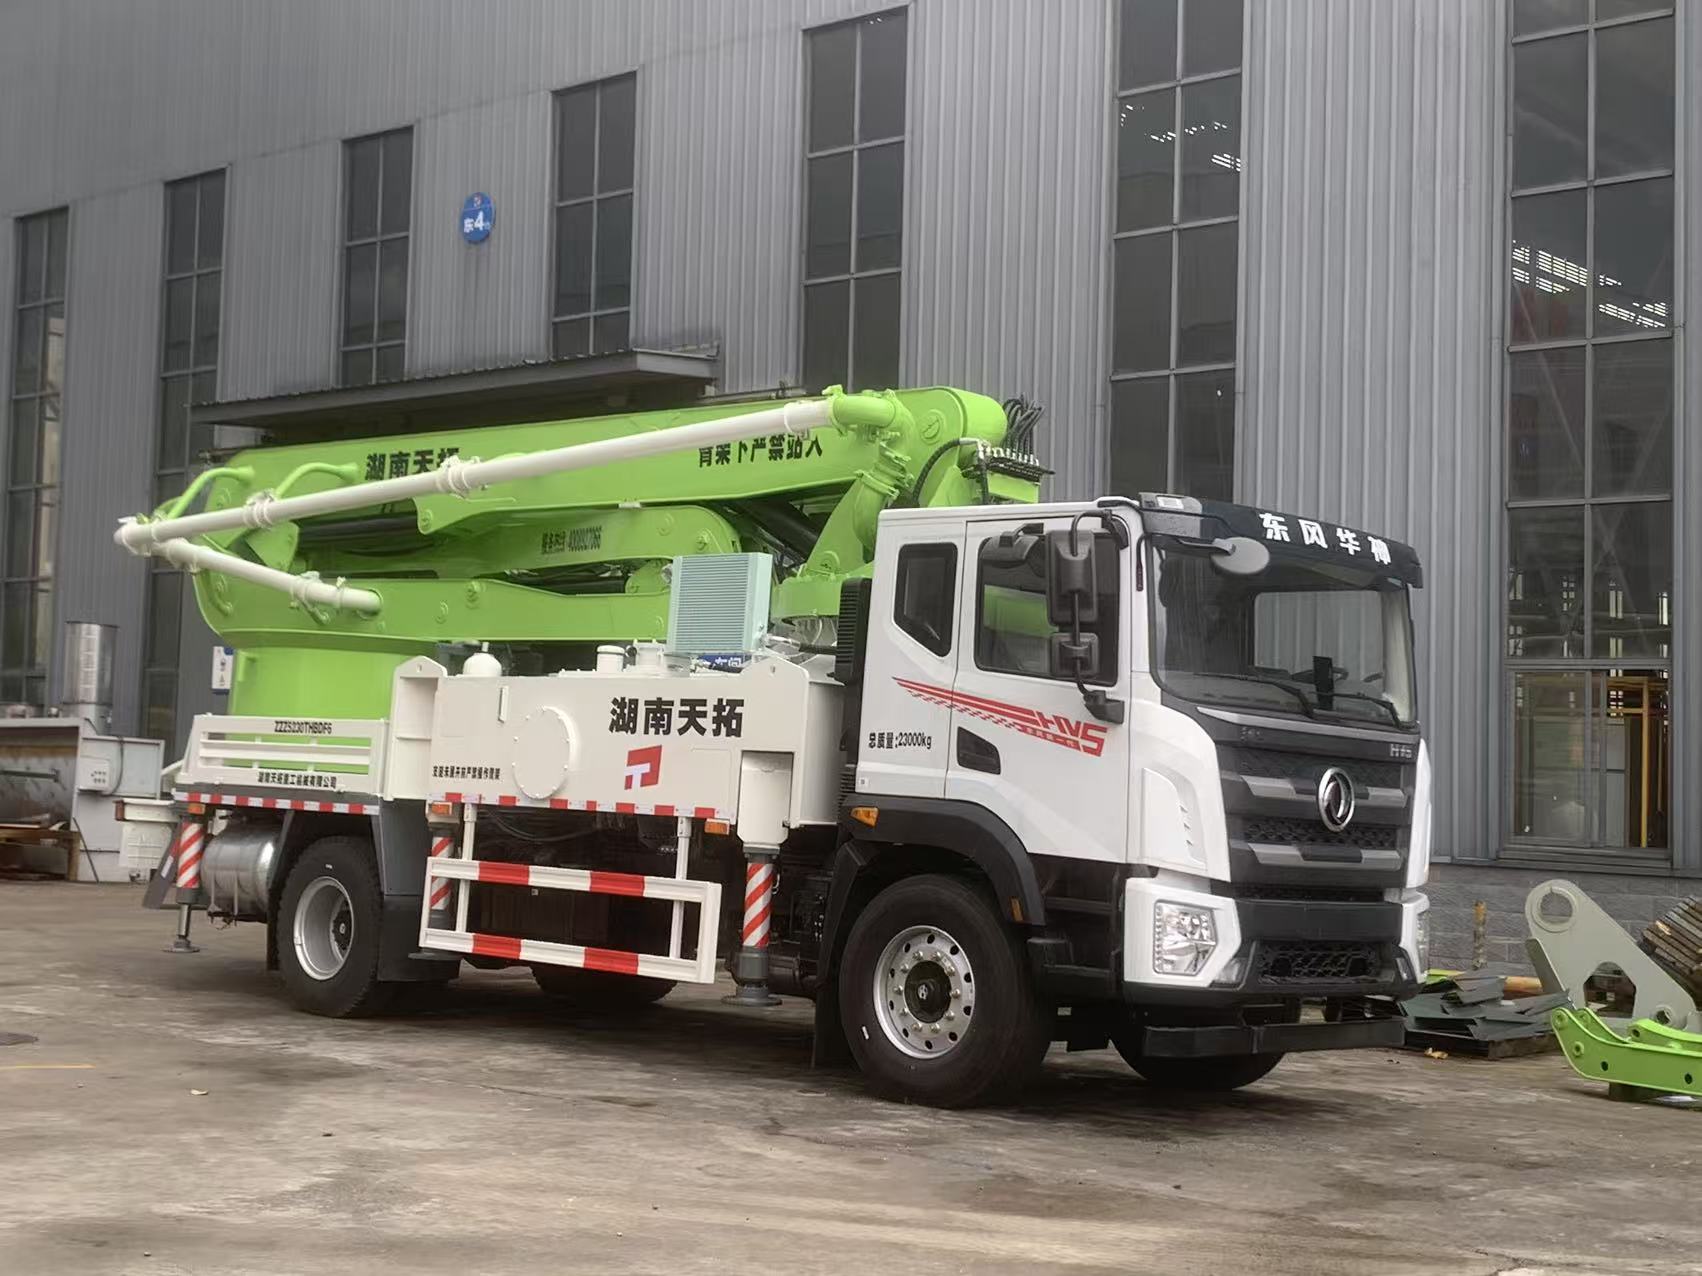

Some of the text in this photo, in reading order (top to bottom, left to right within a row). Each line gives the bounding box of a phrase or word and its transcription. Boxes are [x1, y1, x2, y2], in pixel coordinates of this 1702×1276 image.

[1259, 512, 1392, 565] 东风华神
[608, 696, 745, 738] 湖南天拓
